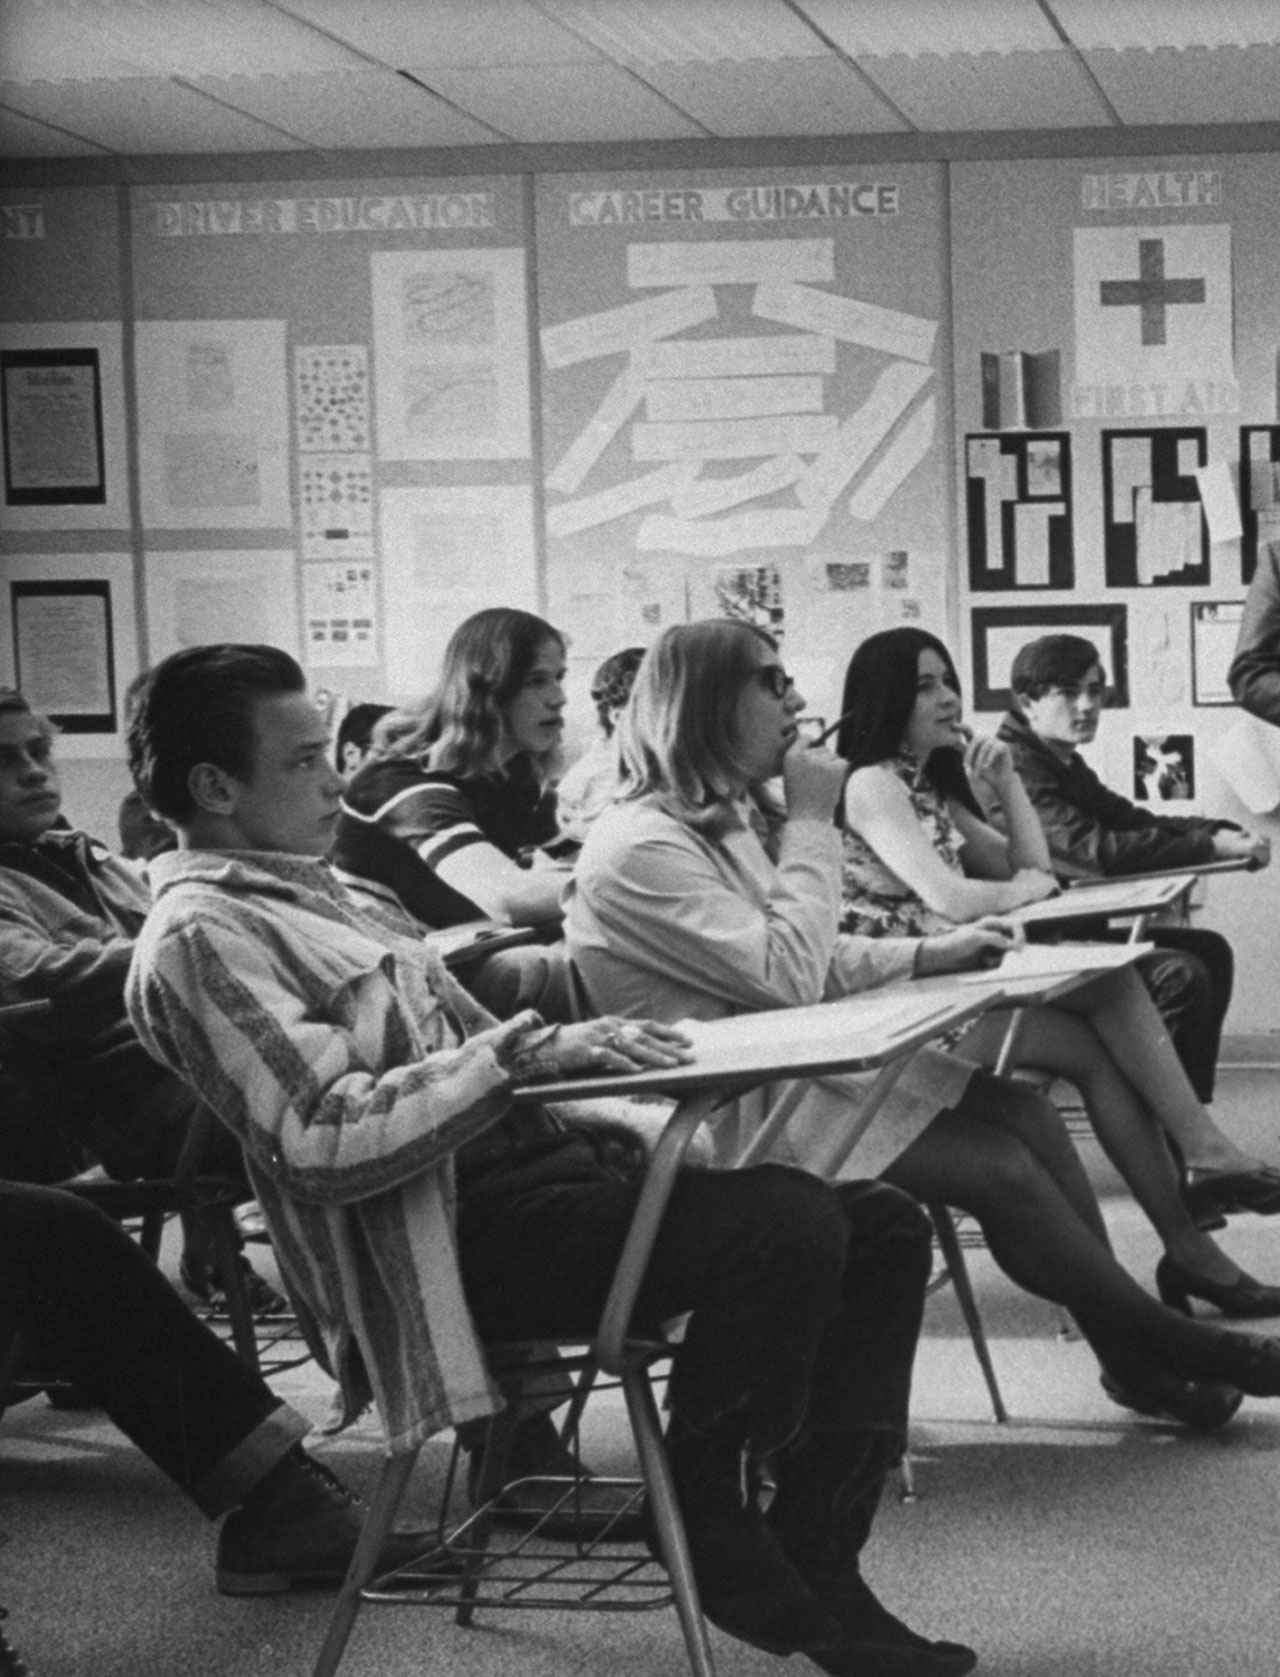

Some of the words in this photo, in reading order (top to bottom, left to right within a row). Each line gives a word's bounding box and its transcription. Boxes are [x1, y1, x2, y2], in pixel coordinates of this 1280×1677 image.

[573, 189, 703, 223] CAREER
[727, 185, 897, 219] GUIDANCE
[1084, 172, 1221, 208] HEALTH
[156, 200, 282, 235] DRIVER
[296, 194, 496, 232] EDUCATION
[1074, 384, 1168, 416] FIRST
[1180, 381, 1239, 413] AID
